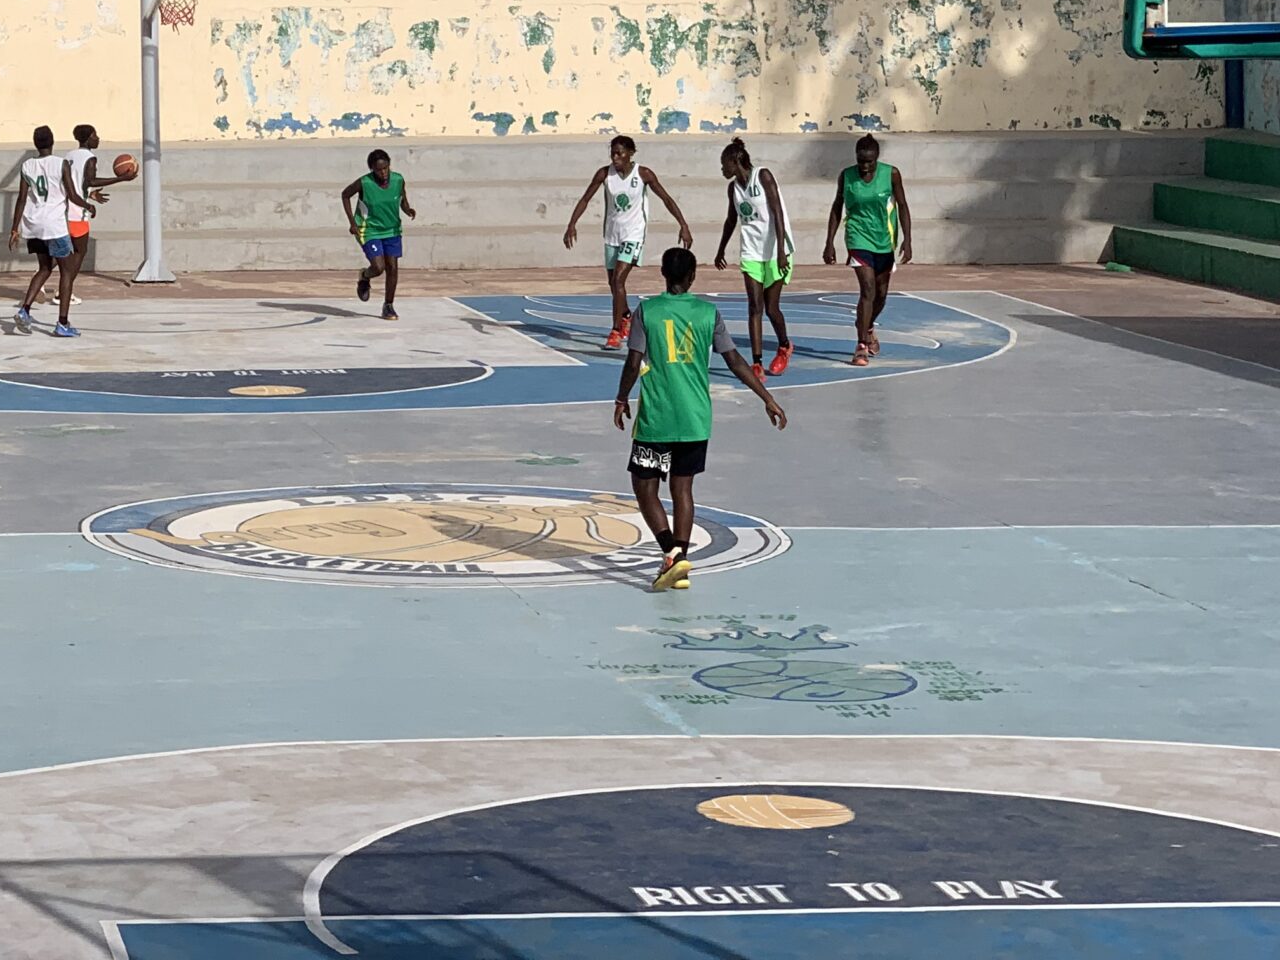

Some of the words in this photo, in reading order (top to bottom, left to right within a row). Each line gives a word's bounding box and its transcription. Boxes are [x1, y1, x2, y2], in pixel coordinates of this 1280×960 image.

[663, 319, 695, 363] 14
[198, 542, 493, 574] BASKETBALL
[630, 884, 794, 907] RIGHT
[827, 881, 905, 902] TO
[931, 879, 1065, 901] PLAY
